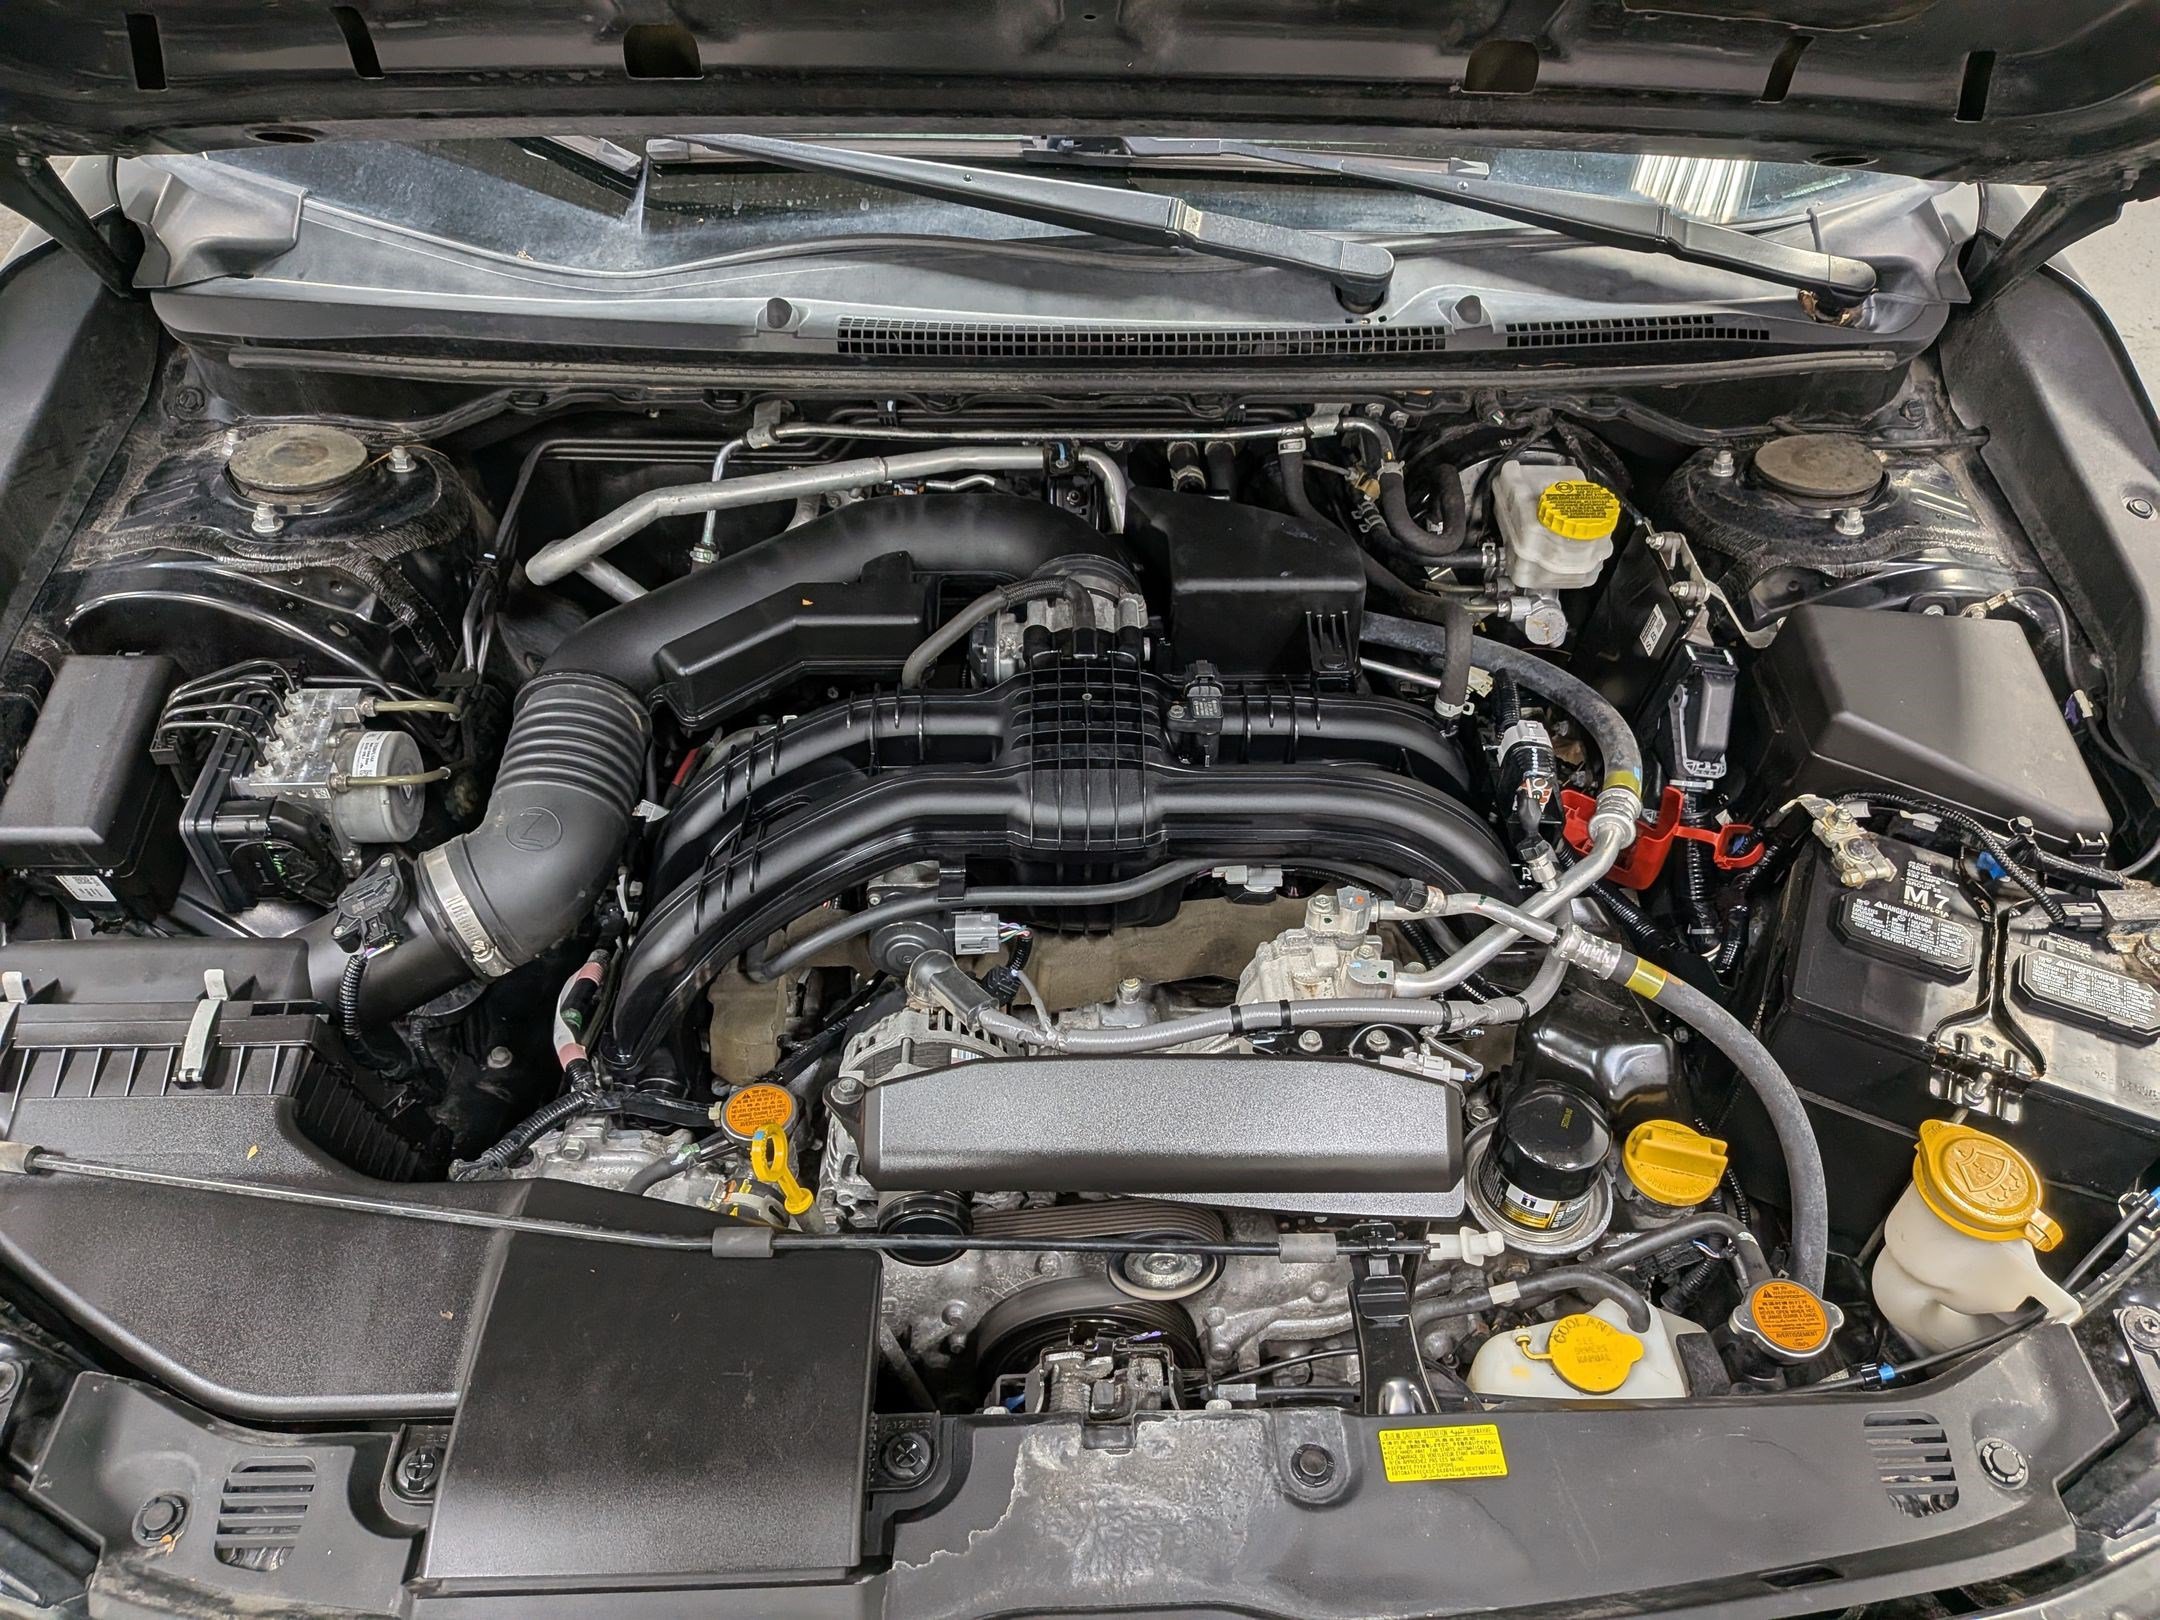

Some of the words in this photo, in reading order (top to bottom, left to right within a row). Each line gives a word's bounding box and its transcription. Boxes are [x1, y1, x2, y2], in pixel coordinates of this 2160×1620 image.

[1904, 885, 1929, 905] M
[1934, 893, 1950, 910] 7
[1882, 902, 1933, 924] DANGER/POISON
